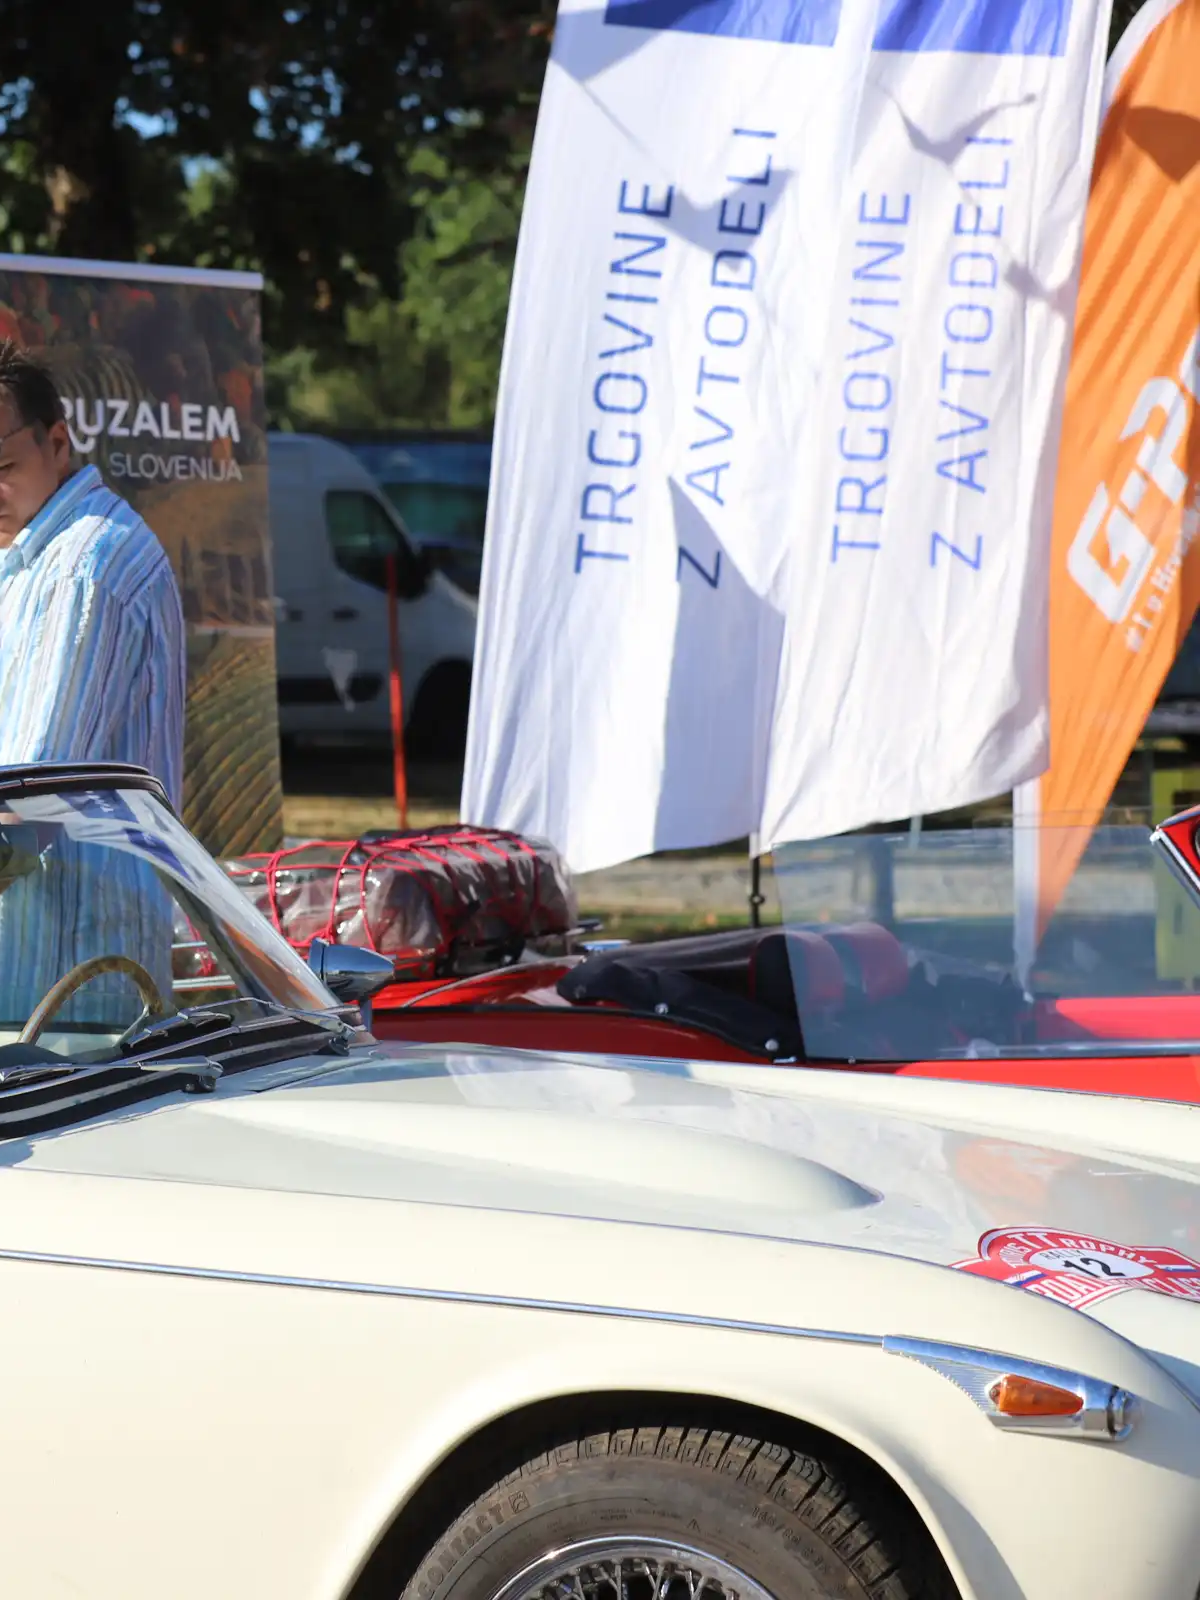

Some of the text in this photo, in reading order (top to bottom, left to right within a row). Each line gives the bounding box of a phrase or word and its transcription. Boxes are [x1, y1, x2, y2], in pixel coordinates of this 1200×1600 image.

[110, 452, 243, 481] SLOVENIJA
[575, 180, 675, 574] TRGOVINE
[676, 127, 777, 589] Z AVTODELI
[830, 192, 911, 563] TRGOVINE
[930, 134, 1013, 571] Z AVTODELI
[1027, 1232, 1158, 1264] TROPHY
[1062, 1257, 1126, 1279] 12
[417, 1502, 505, 1598] CONTACT
